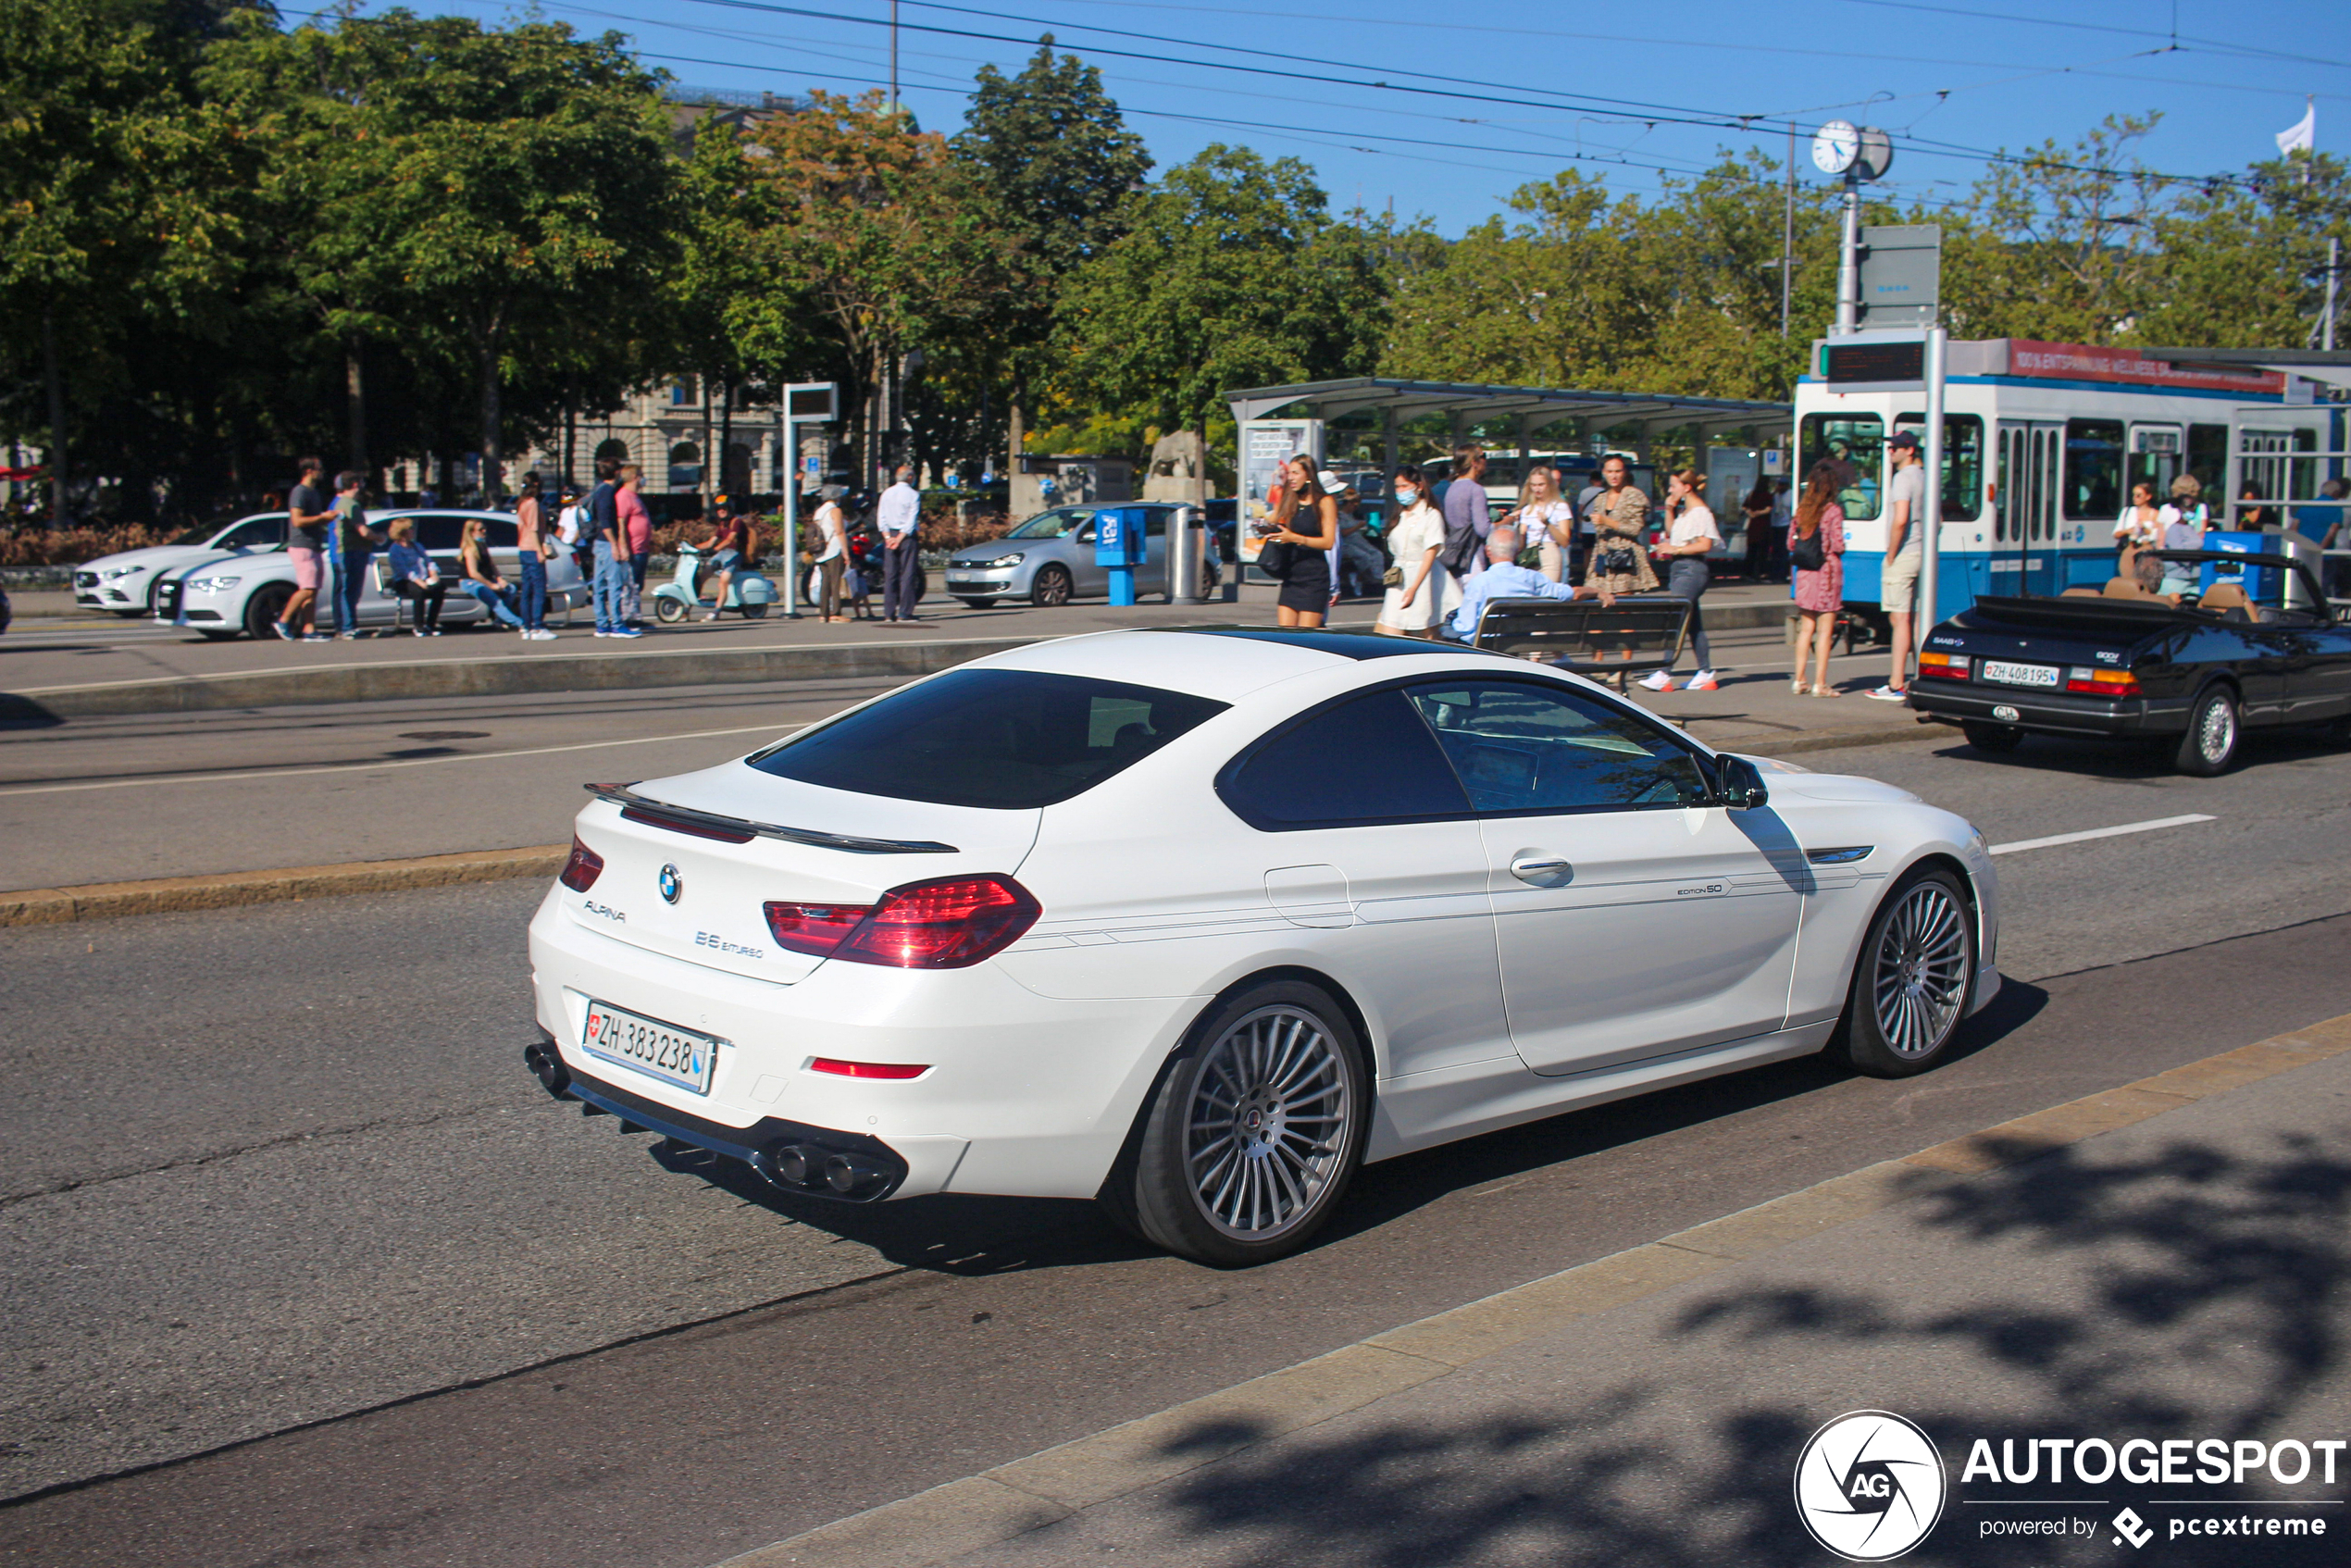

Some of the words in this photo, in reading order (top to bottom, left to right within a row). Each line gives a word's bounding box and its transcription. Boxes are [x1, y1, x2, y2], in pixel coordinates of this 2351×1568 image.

[1933, 637, 1954, 645] SAAB
[1997, 706, 2017, 719] CH
[583, 900, 627, 924] ALPINA
[695, 930, 721, 950] B6
